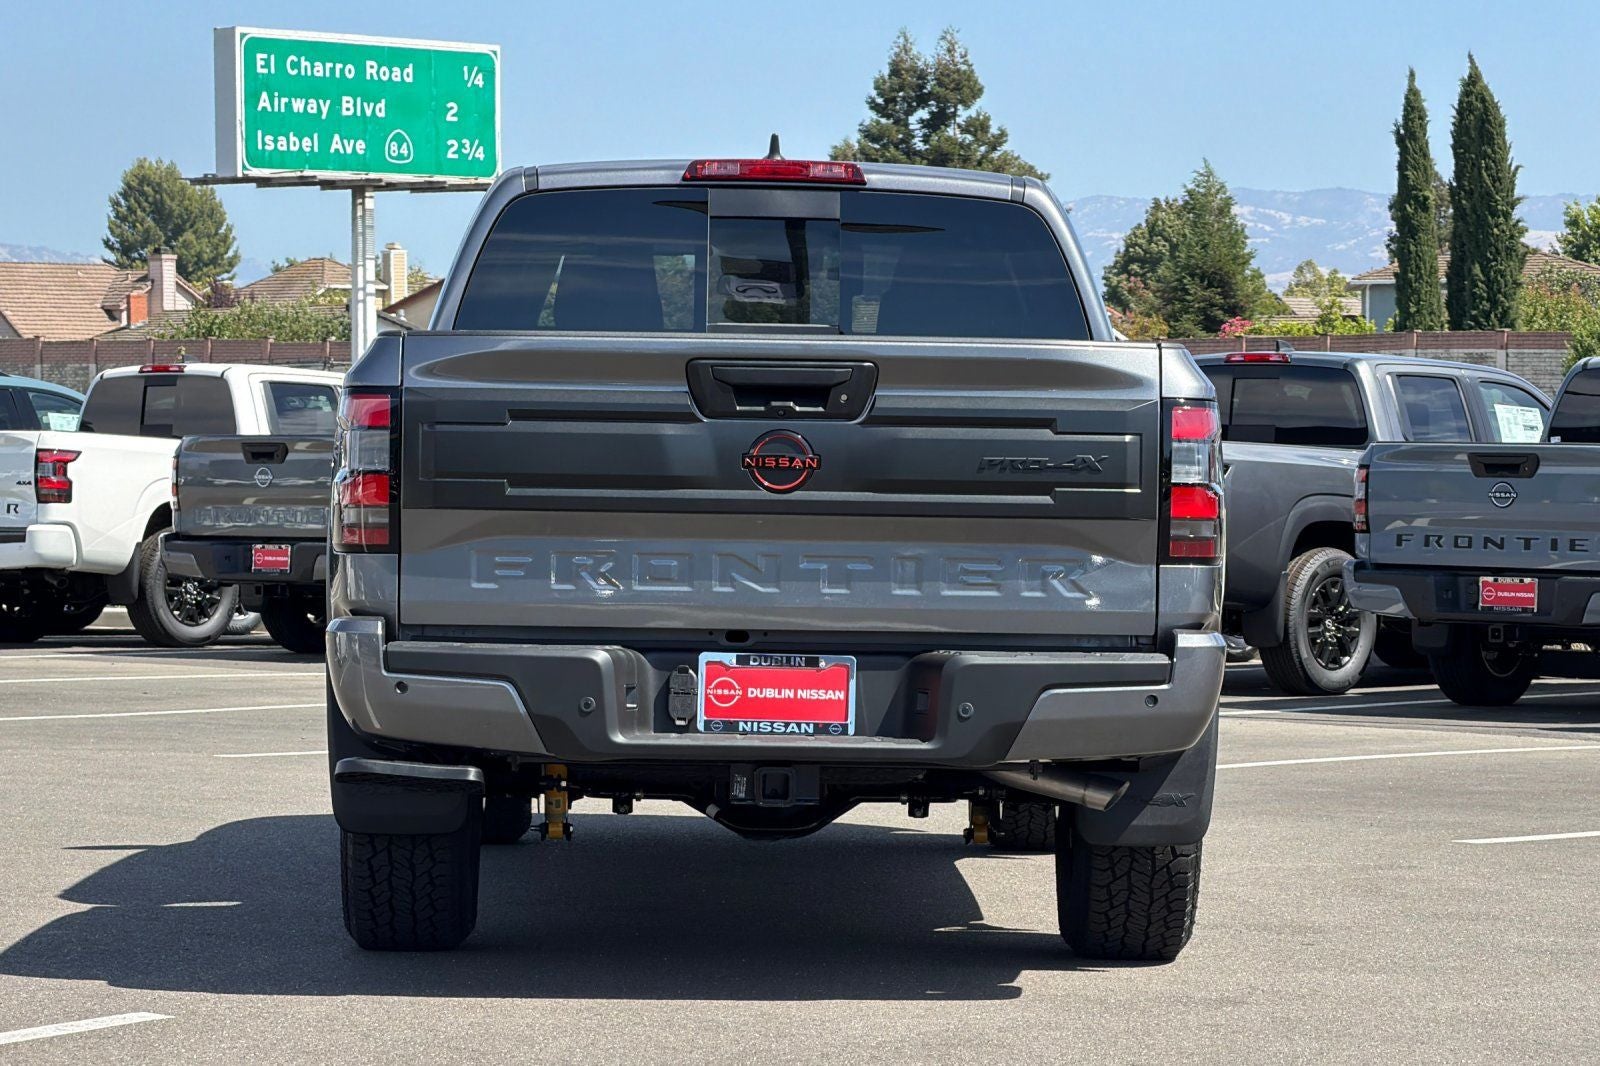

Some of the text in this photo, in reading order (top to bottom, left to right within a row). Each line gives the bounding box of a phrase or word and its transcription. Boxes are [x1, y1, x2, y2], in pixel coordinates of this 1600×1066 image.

[255, 53, 276, 74] El
[285, 55, 355, 79] Charro
[365, 60, 414, 83] Road
[256, 91, 459, 122] Airway Blvd 2
[257, 130, 319, 153] Isabel
[329, 133, 367, 155] Ave
[390, 141, 409, 157] 84
[744, 457, 818, 468] NISSAN
[469, 550, 1094, 597] FRONTIER
[749, 655, 806, 666] DUBLIN
[747, 687, 845, 701] DUBLIN NISSAN
[738, 721, 814, 734] NISSAN
